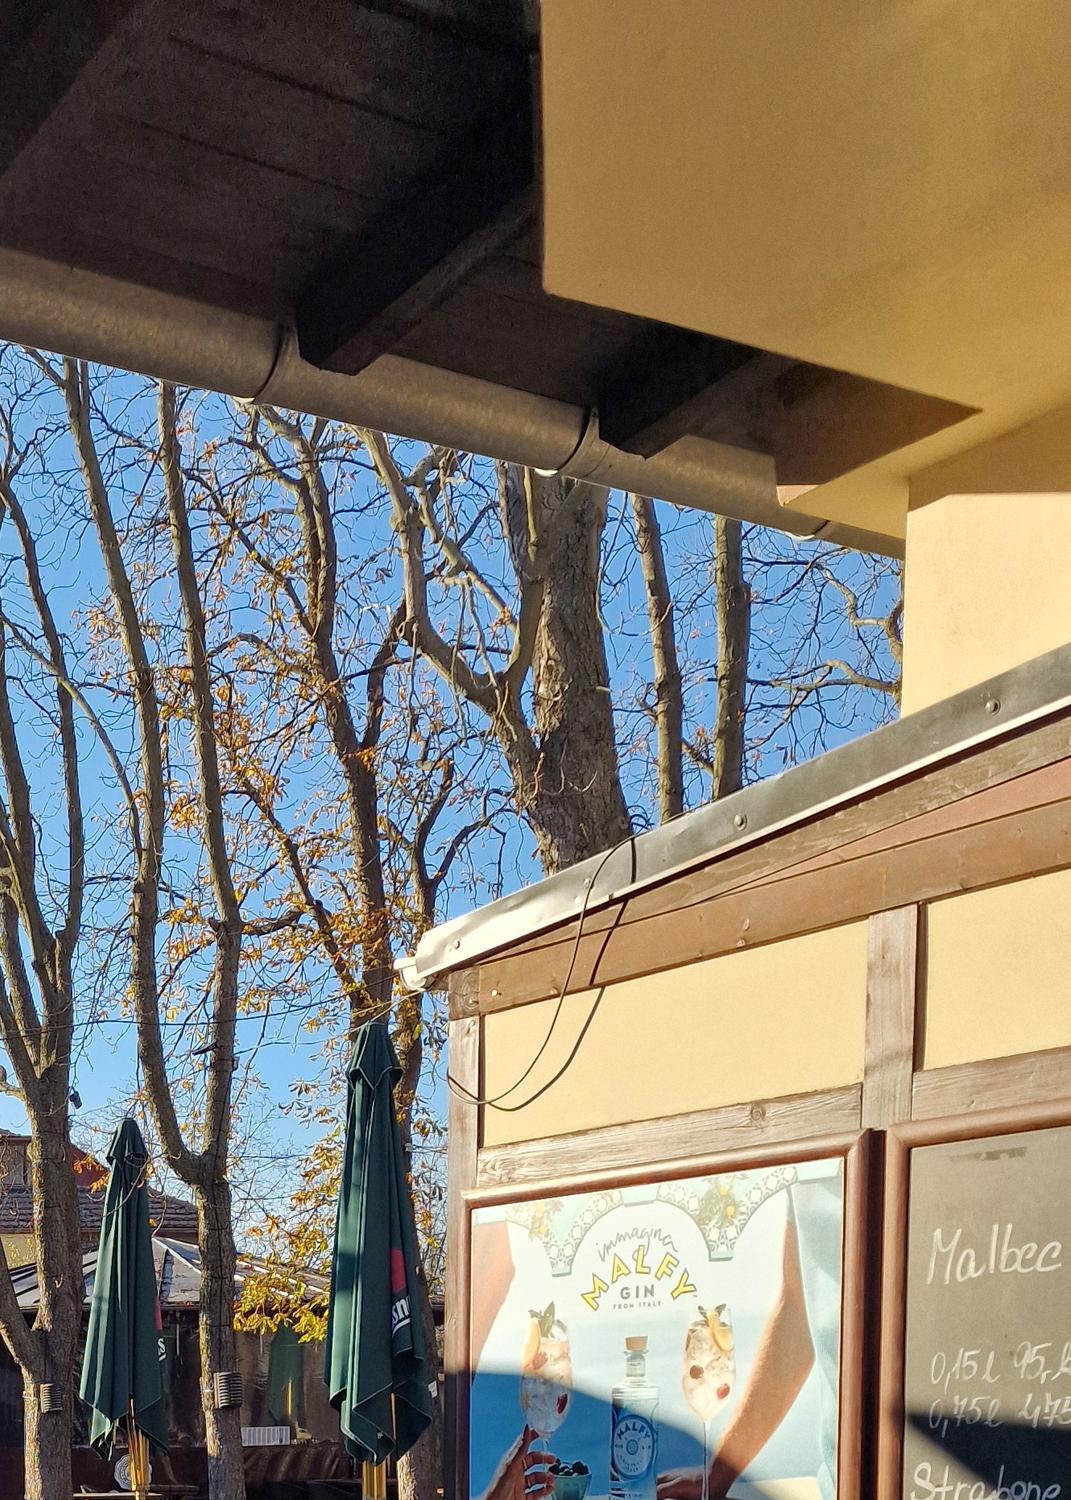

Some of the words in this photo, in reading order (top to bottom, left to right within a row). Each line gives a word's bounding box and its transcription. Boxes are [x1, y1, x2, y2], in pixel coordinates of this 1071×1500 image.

[580, 1244, 698, 1311] MALFY
[620, 1284, 655, 1300] GIN
[638, 1300, 662, 1308] ITALY
